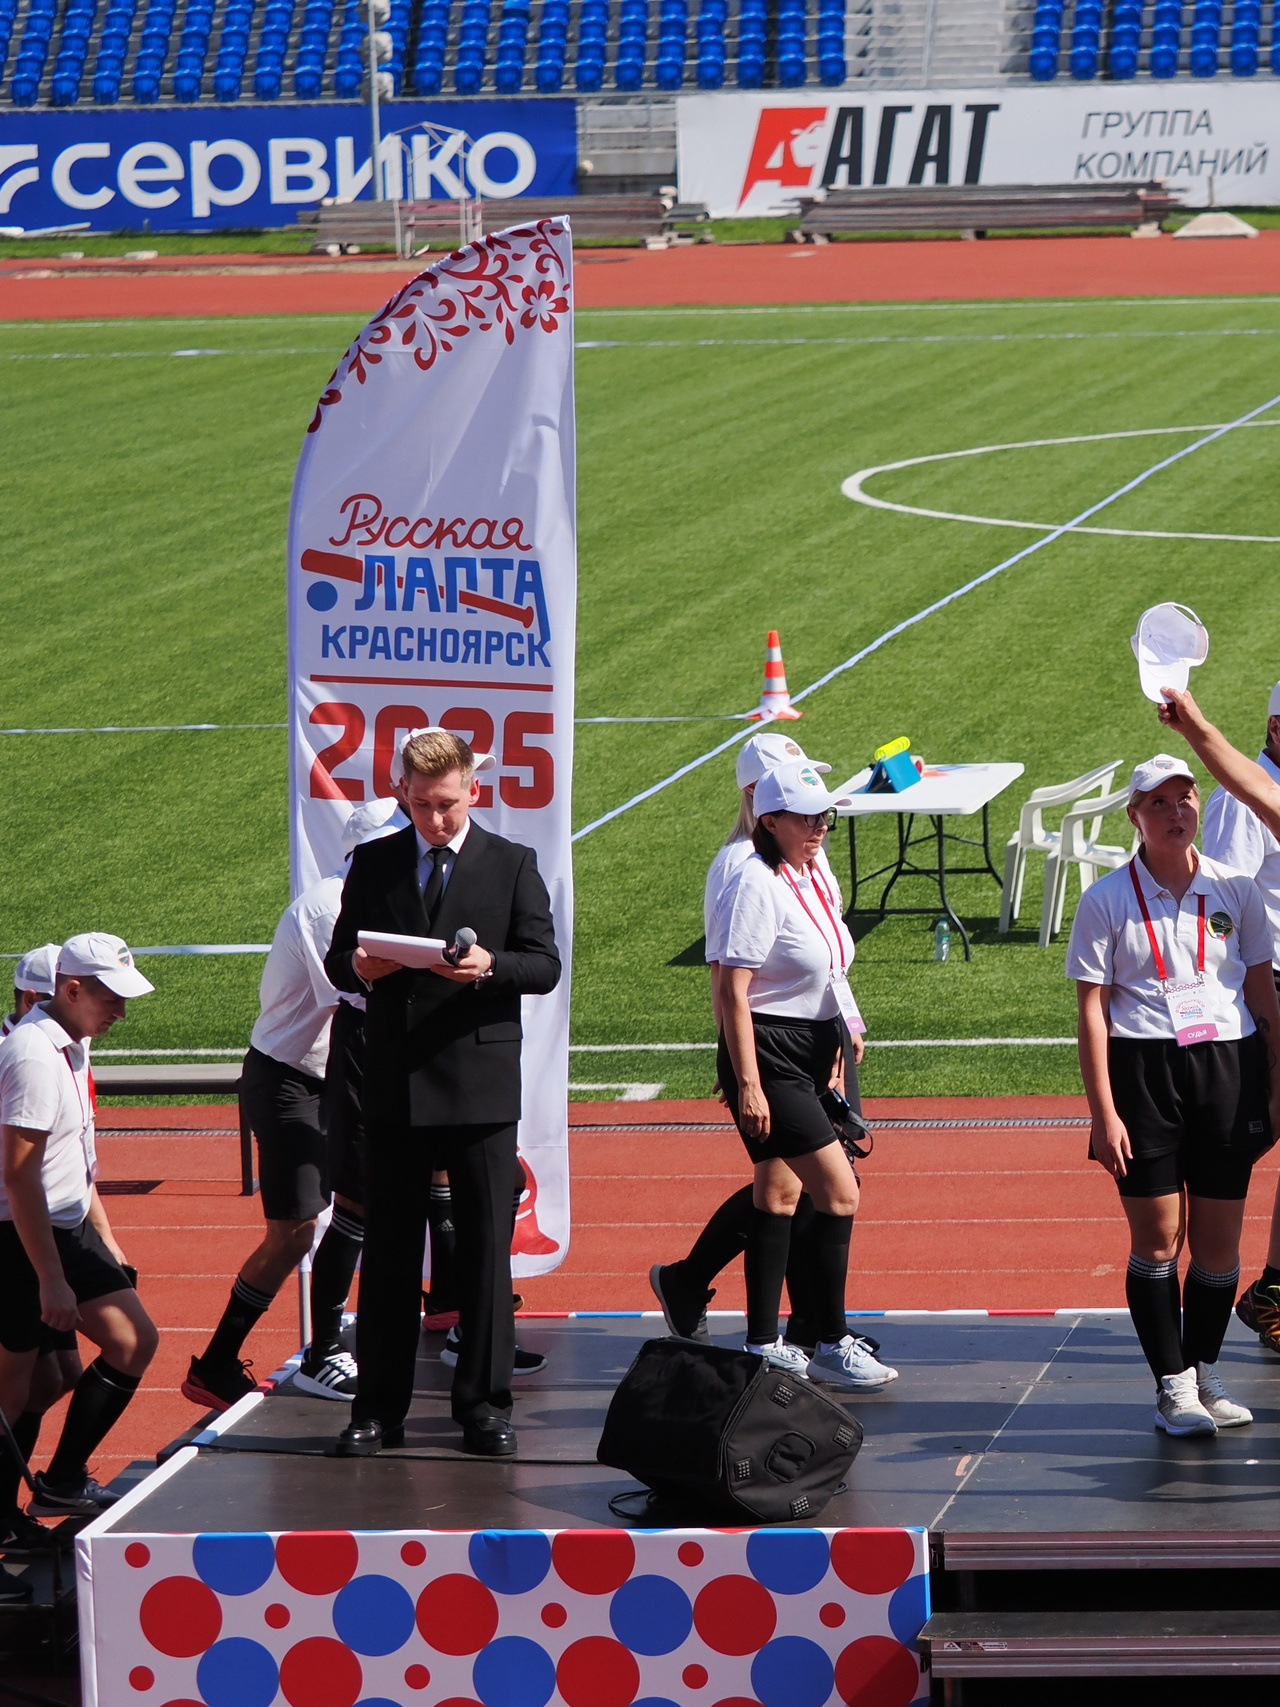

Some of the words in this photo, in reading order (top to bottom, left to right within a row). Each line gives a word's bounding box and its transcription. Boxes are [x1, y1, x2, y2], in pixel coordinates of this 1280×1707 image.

[822, 104, 1000, 187] АГАТ
[1082, 109, 1214, 139] ГРУППА
[51, 131, 537, 218] сервико
[1075, 141, 1269, 180] КОМПАНИЙ
[328, 493, 534, 551] Русская
[354, 554, 551, 640] ЛАПТА
[320, 624, 552, 668] КРАСНОЯРСК
[1188, 1030, 1207, 1038] СУДЬЯ
